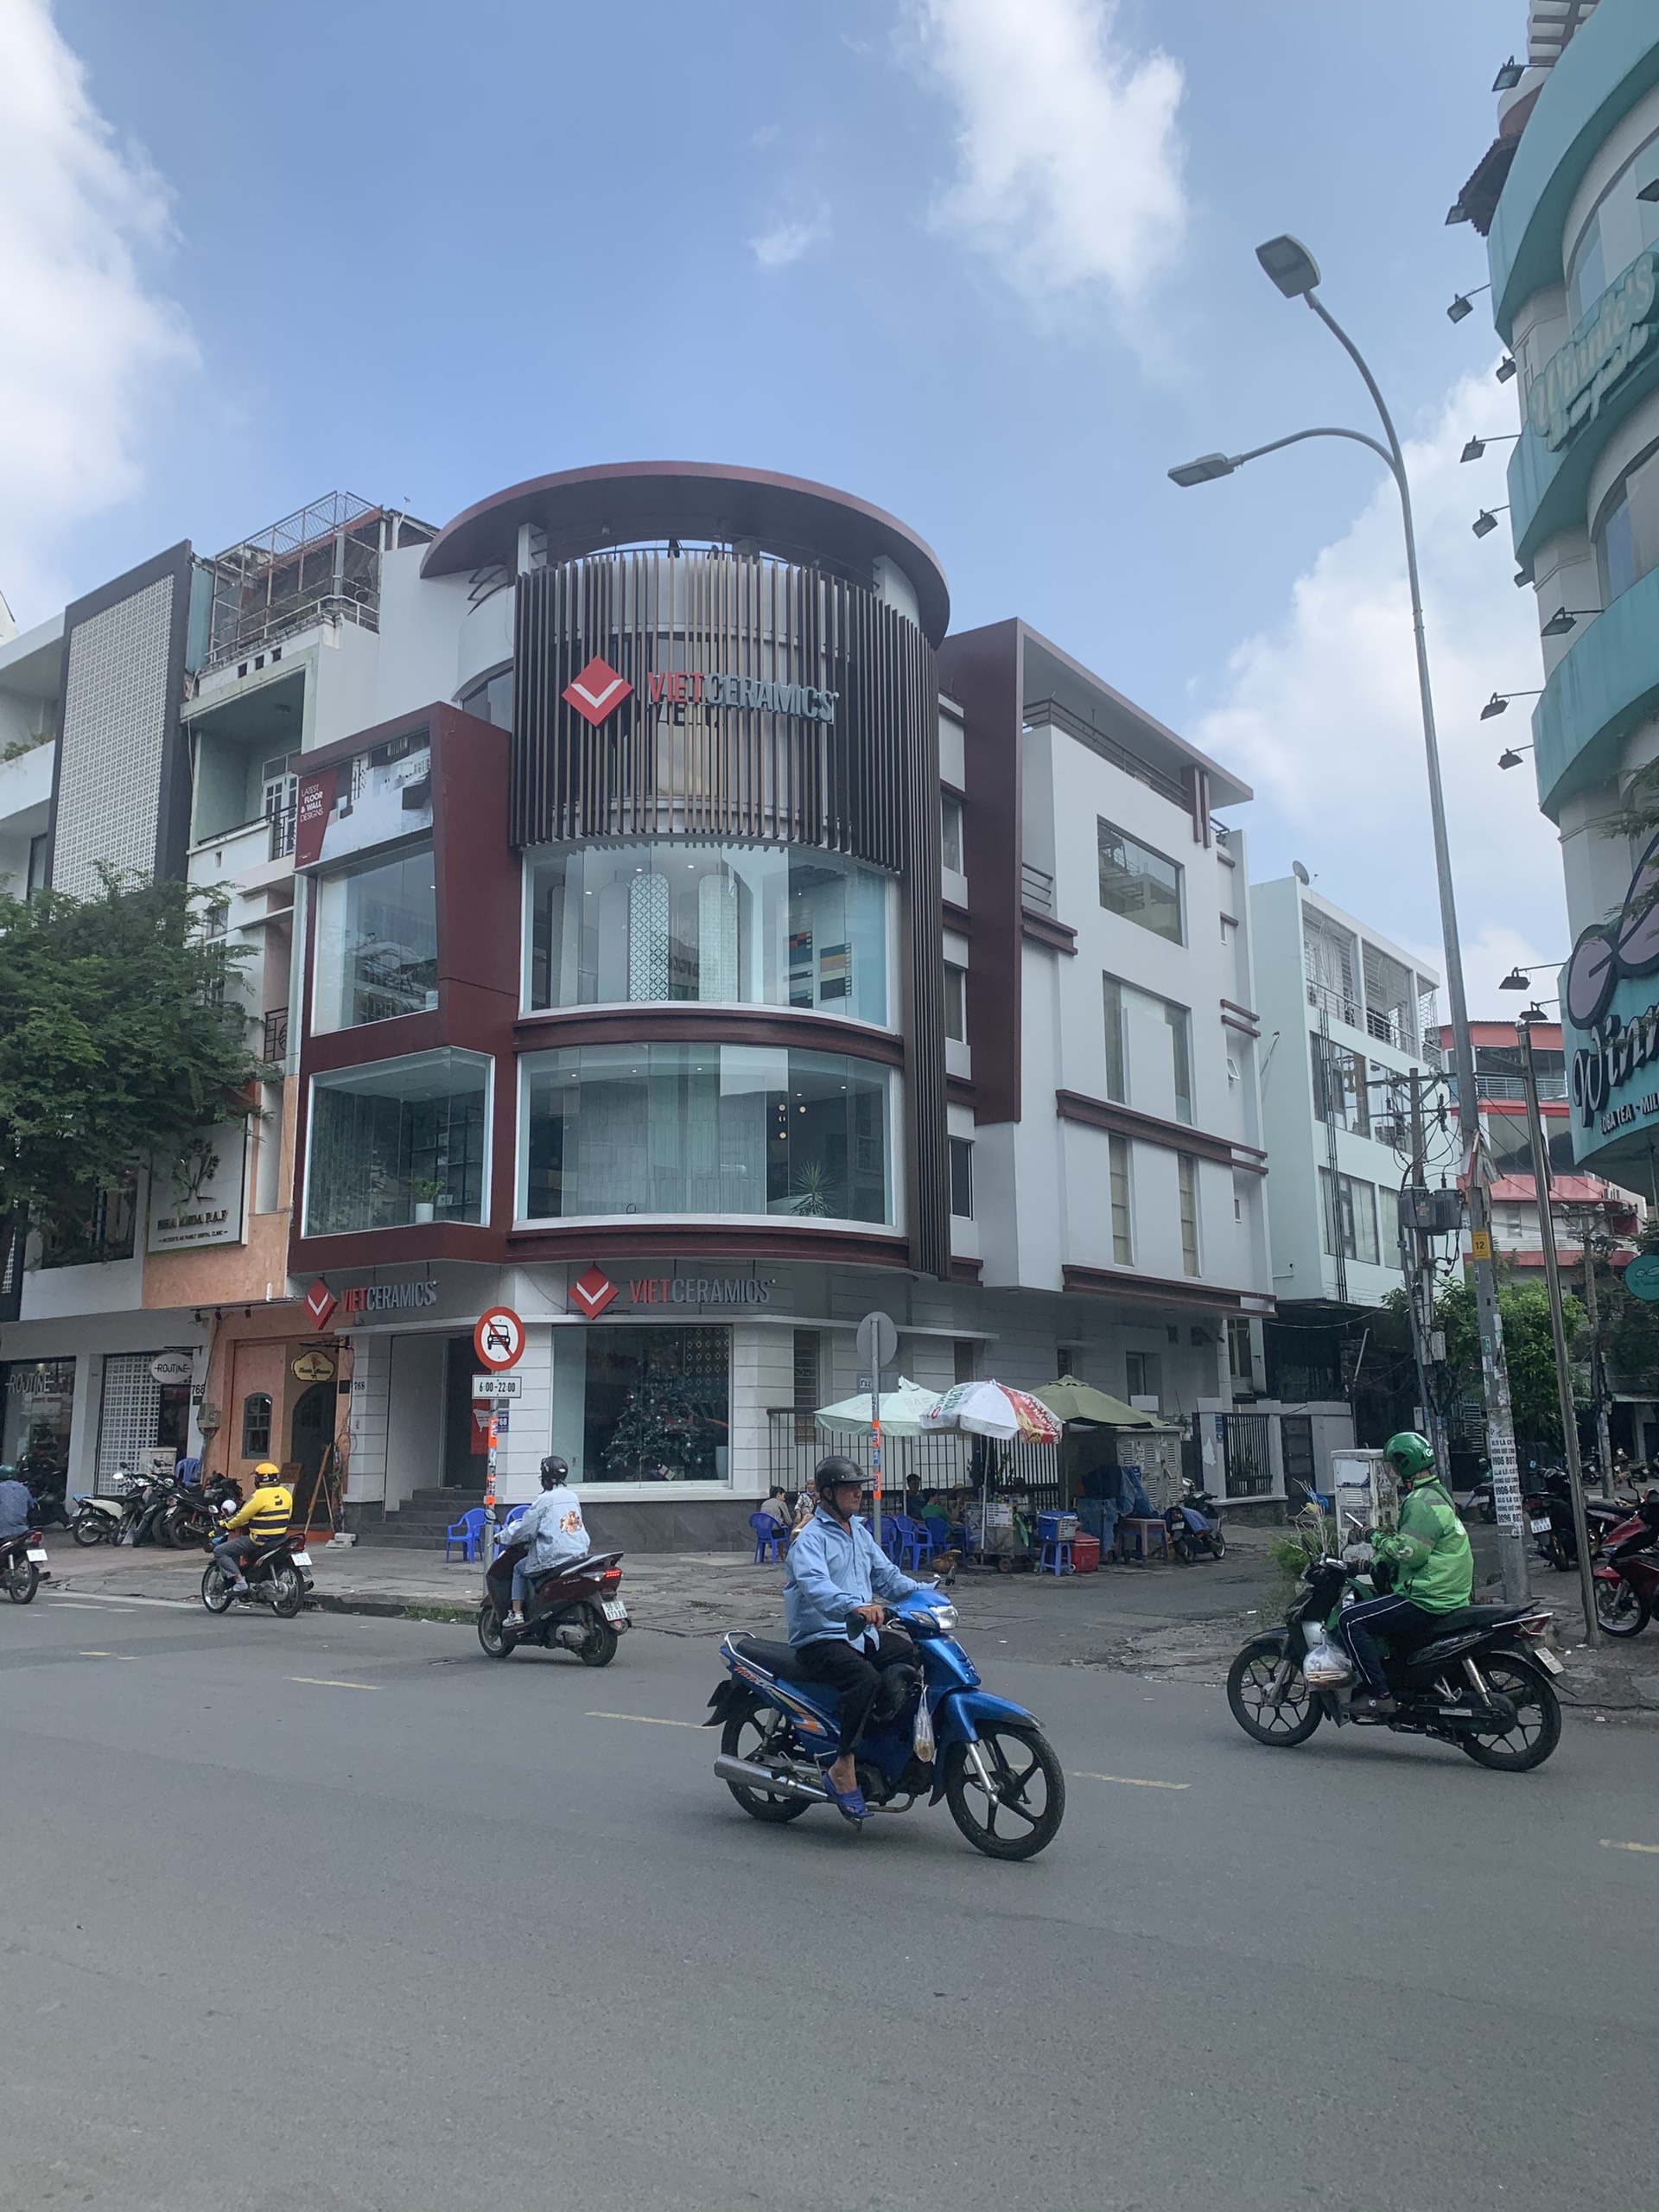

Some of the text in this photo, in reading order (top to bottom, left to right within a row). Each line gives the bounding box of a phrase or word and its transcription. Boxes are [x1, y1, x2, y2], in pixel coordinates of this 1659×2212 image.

[301, 784, 320, 797] LATEST
[304, 791, 324, 804] FLOOR
[300, 800, 322, 814] & WALL
[300, 808, 324, 823] DESIGNS
[1617, 1104, 1634, 1125] TEA
[1475, 1241, 1485, 1250] 12
[156, 1363, 188, 1375] ROUTINE
[191, 1384, 206, 1395] 768
[353, 1382, 365, 1390] 768
